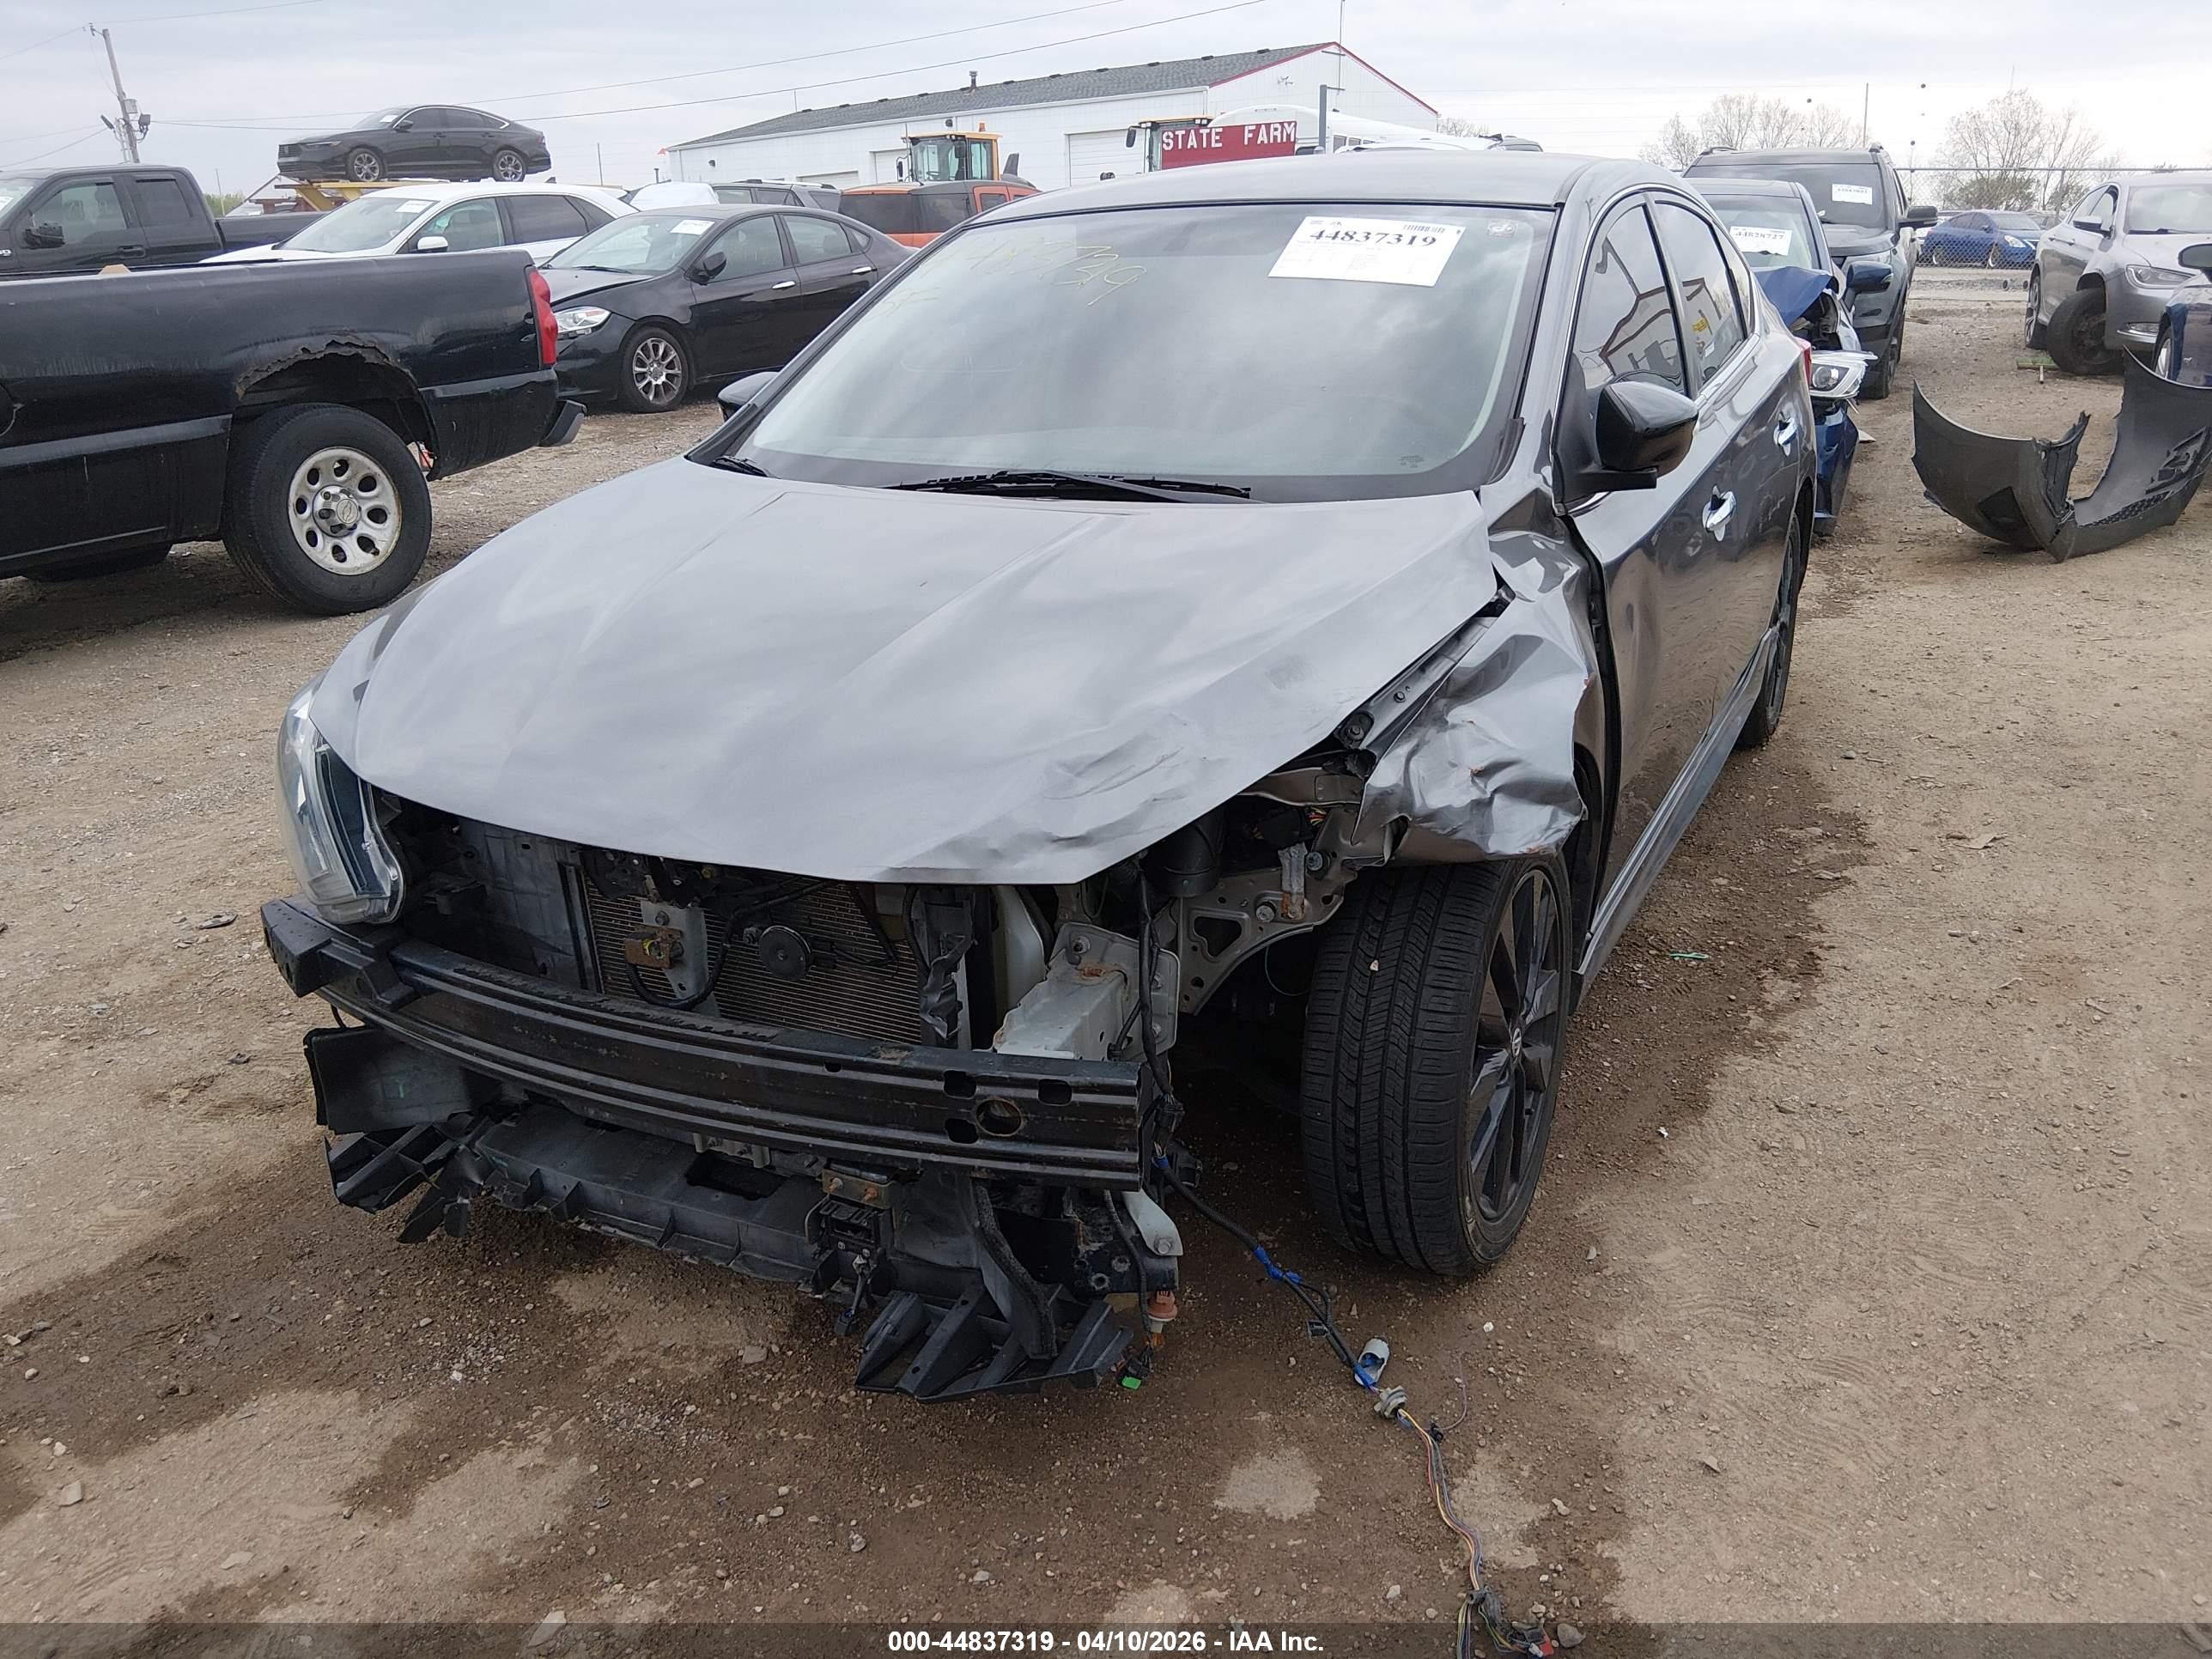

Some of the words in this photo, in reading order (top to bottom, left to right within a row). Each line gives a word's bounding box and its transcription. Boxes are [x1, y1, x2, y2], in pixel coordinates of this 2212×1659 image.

[1162, 127, 1224, 151] STATE
[1243, 122, 1296, 146] FARM
[1310, 228, 1437, 247] 44837319
